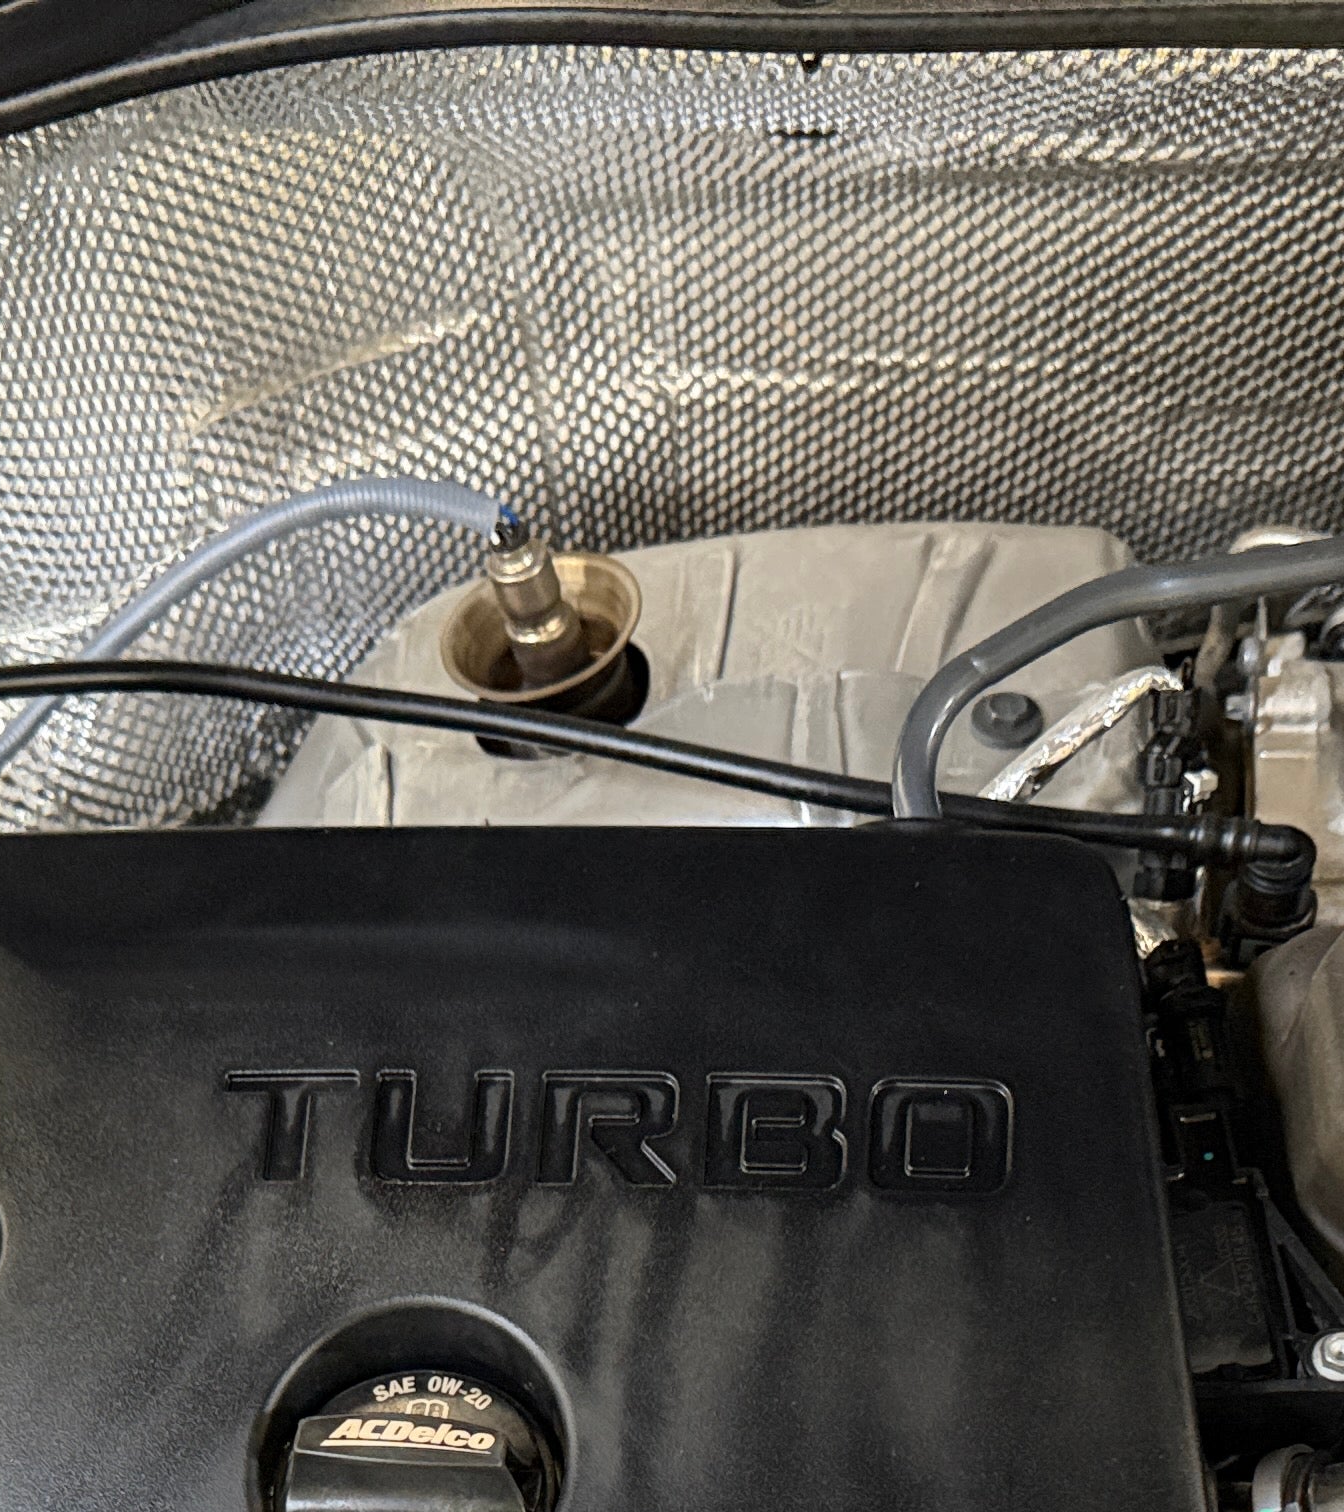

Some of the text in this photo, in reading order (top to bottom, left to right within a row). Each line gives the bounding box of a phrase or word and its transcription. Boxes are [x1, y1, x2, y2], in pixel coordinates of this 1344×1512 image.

[224, 1069, 1015, 1193] TURBO
[372, 1375, 493, 1411] SAE 0W-20
[328, 1418, 496, 1450] ACDelco
